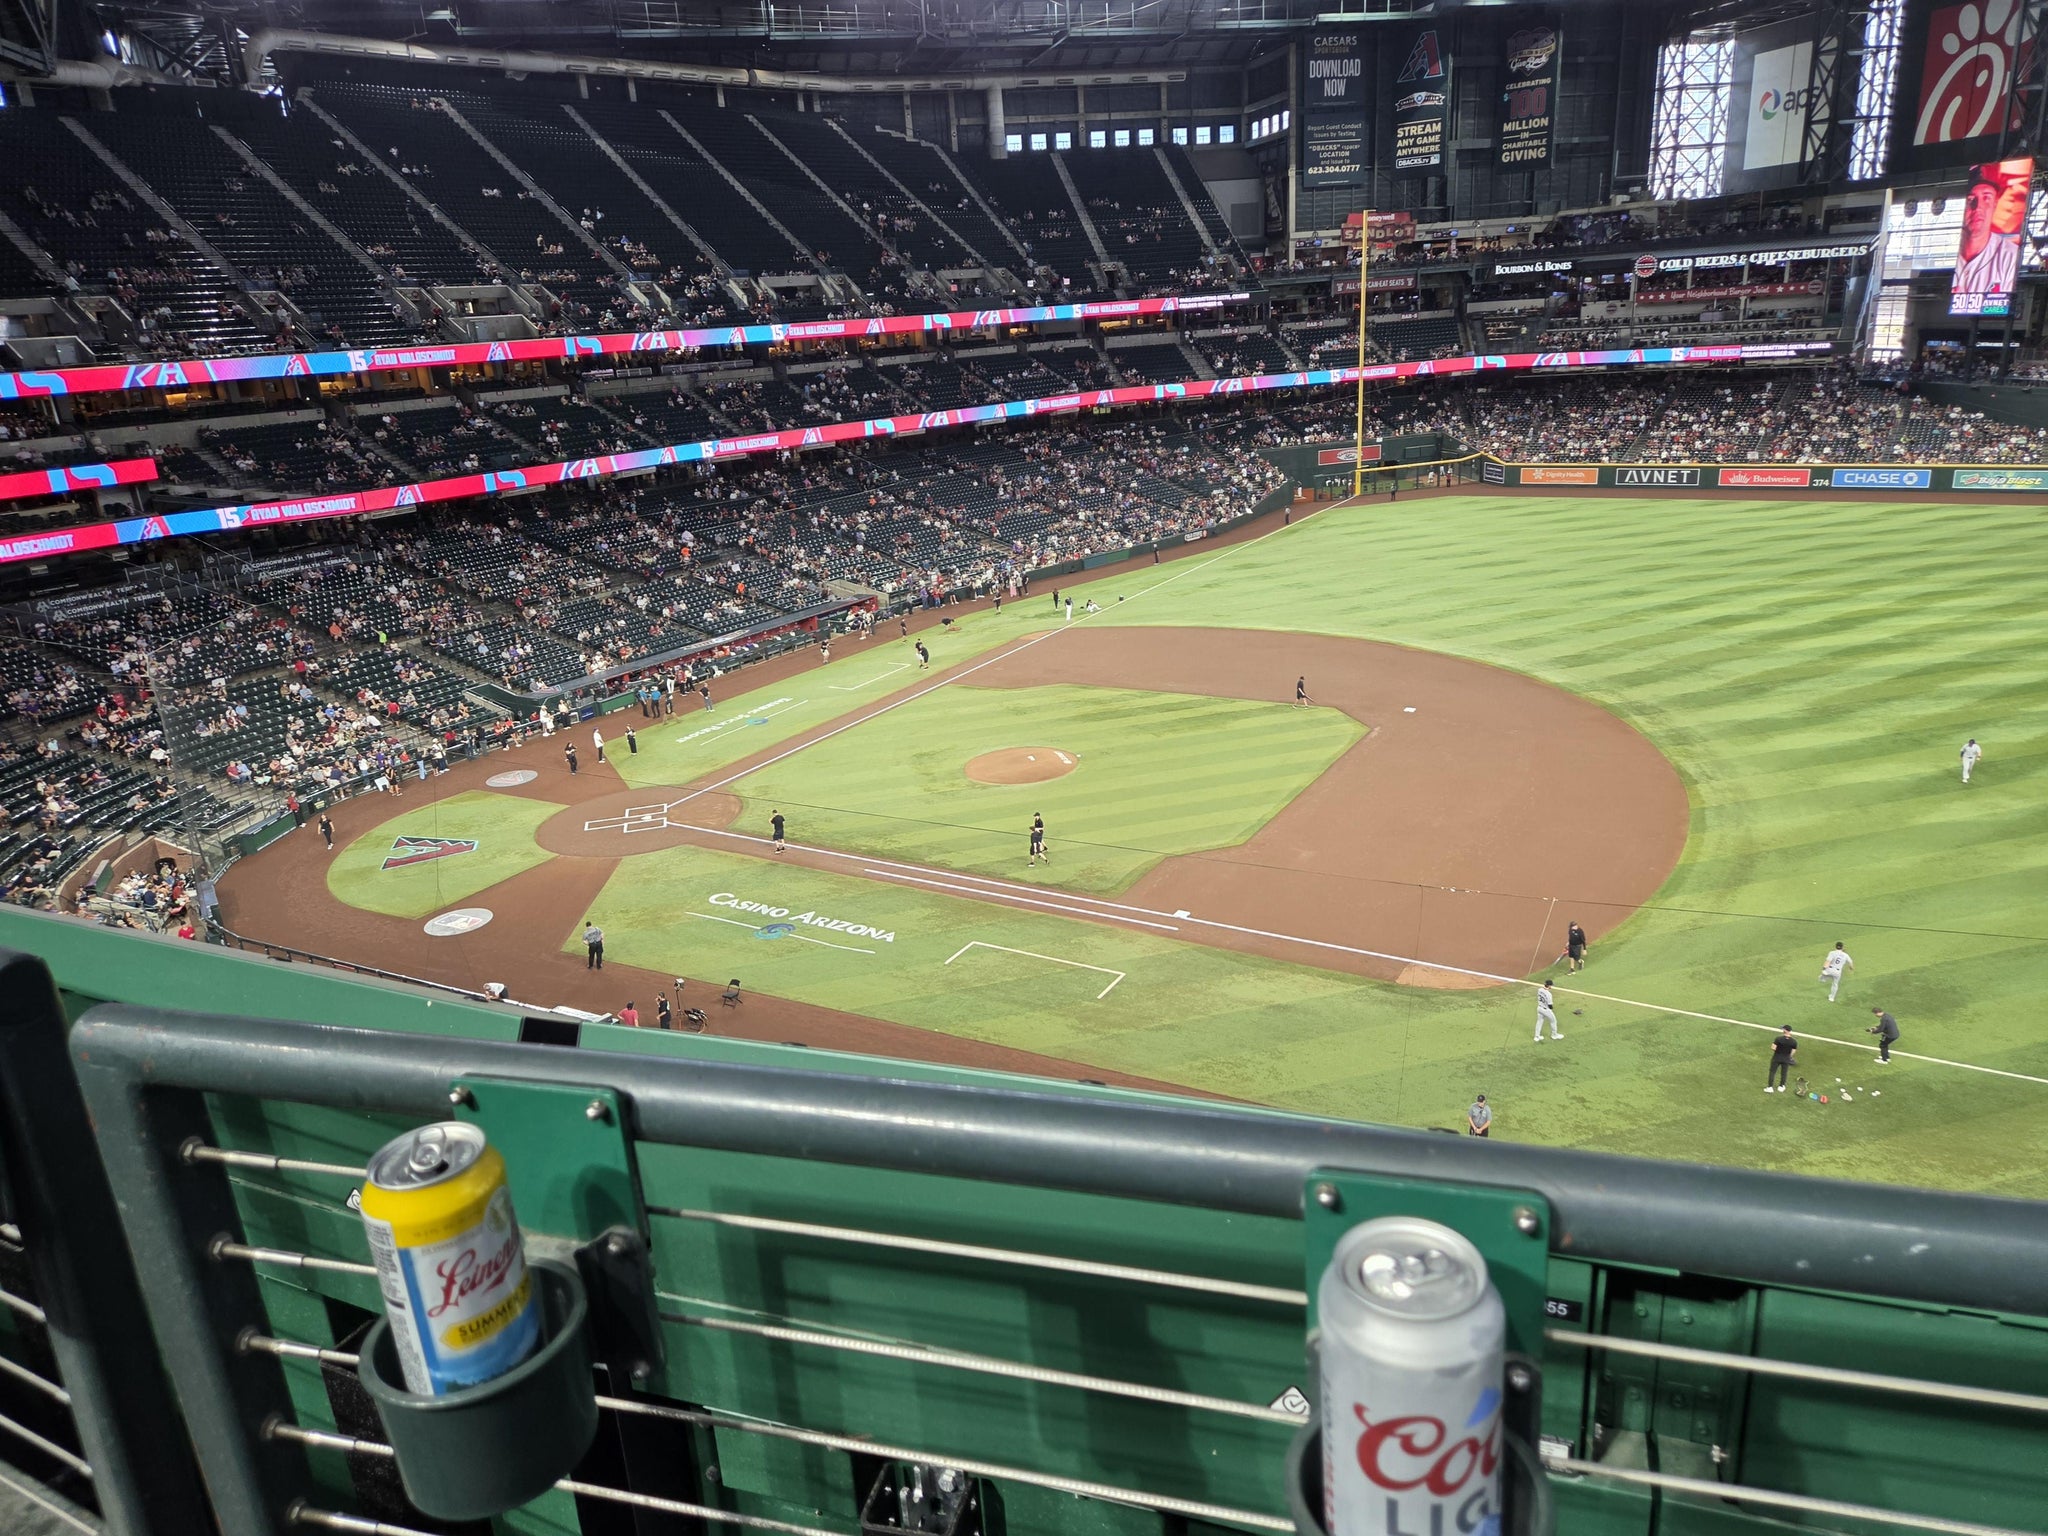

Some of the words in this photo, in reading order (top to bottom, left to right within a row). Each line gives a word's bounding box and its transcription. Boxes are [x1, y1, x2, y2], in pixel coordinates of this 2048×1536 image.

[1314, 36, 1357, 46] CAESARS
[1309, 58, 1361, 78] DOWNLOAD
[1324, 78, 1347, 97] NOW
[1505, 77, 1552, 90] CELEBRATING
[1397, 122, 1441, 137] STREAM
[1503, 117, 1549, 132] MILLION
[1396, 138, 1414, 147] ANY
[1416, 134, 1441, 144] GAME
[1520, 131, 1529, 139] IN
[1396, 144, 1441, 156] ANYWHERE
[1502, 138, 1547, 150] CHARITABLE
[1502, 147, 1547, 163] GIVING
[1308, 164, 1361, 174] 623.304.0777
[1659, 257, 1693, 270] COLD
[1695, 254, 1738, 267] BEERS
[1738, 254, 1748, 264] &
[1750, 245, 1868, 263] CHEESEBURGERS
[1534, 262, 1544, 272] &
[1389, 278, 1405, 286] SEATS
[770, 324, 784, 341] 15
[347, 350, 367, 371] 15
[702, 441, 714, 458] 15
[1625, 470, 1691, 483] AVNET
[1752, 475, 1801, 483] Budweiser
[1812, 479, 1829, 487] 374
[1844, 473, 1900, 484] CHASE
[217, 506, 242, 529] 15
[251, 505, 281, 521] RYAN
[282, 497, 356, 517] WALDSCHMIDT
[50, 589, 112, 606] COMMONWEALTH
[67, 598, 129, 615] COMMONWEALTH
[133, 591, 165, 602] TERRACE
[1544, 1300, 1568, 1316] 55
